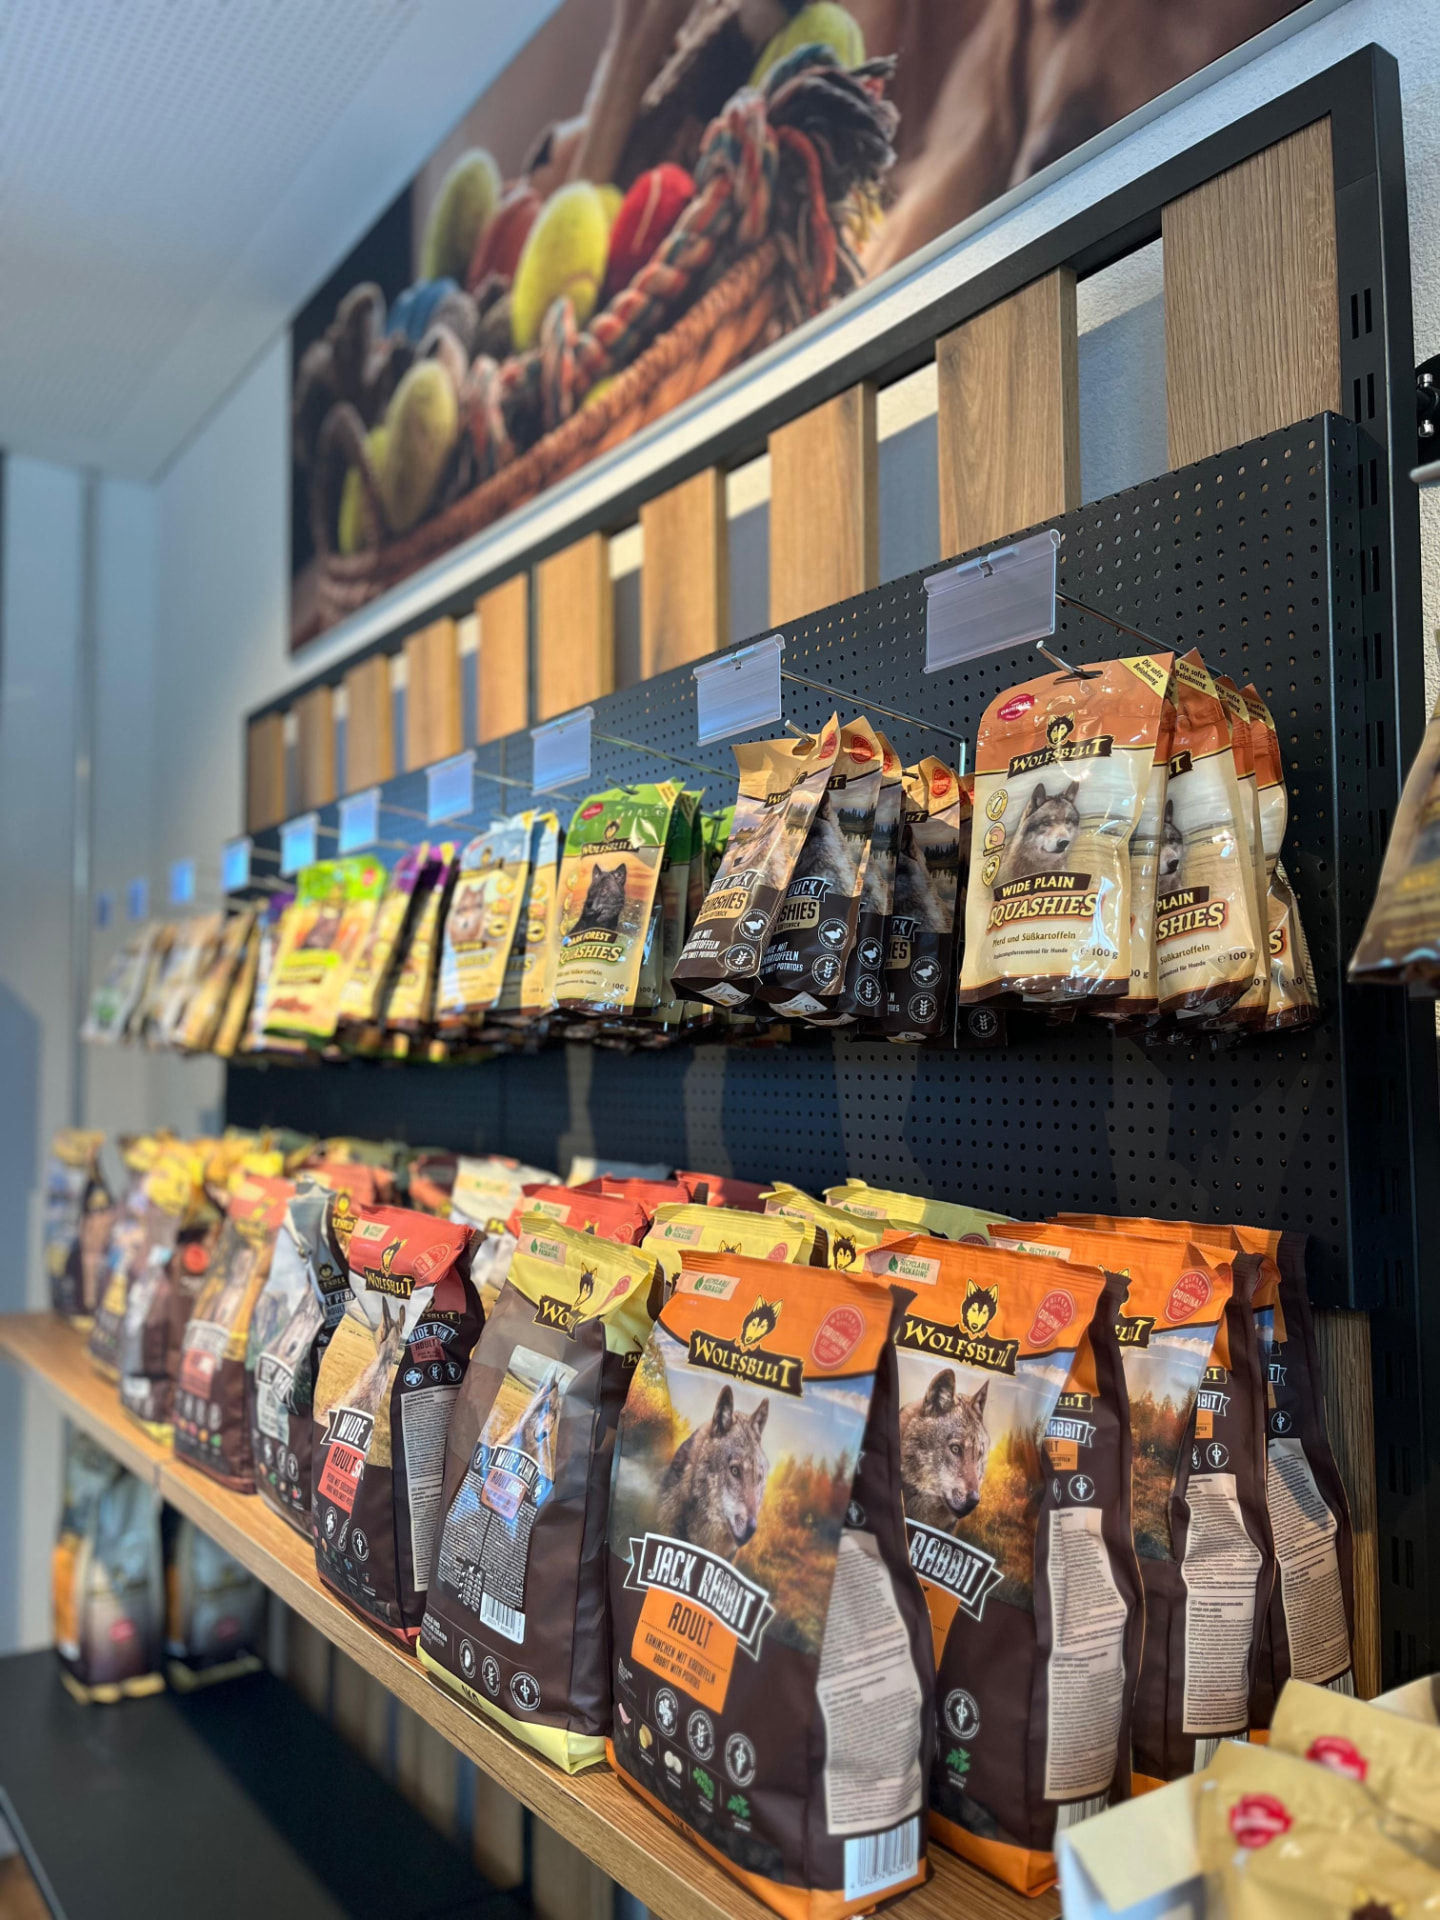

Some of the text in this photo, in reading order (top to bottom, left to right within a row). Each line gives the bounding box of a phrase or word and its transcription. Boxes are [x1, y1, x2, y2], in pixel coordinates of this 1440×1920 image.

[1141, 659, 1164, 679] Die softe
[1179, 662, 1207, 681] Die softe
[1012, 738, 1109, 772] WOLFSBLUT
[1002, 876, 1075, 898] WIDE PLAIN
[987, 893, 1100, 930] SQUASHIES
[1156, 891, 1194, 912] PLAIN
[1157, 902, 1226, 941] SHIES
[1022, 930, 1077, 942] Süßkartoffeln
[1092, 947, 1110, 957] 100
[1228, 951, 1247, 962] 100
[899, 1266, 928, 1279] PACKAGING
[900, 1258, 930, 1271] RECYCLABLE
[365, 1271, 414, 1297] WOLFSBLUT
[903, 1319, 1016, 1368] WOLFSBLUT
[694, 1335, 798, 1388] WOLFSBLUT
[336, 1412, 369, 1446] WIDE
[909, 1530, 984, 1594] RABBIT
[647, 1544, 756, 1630] JACK RABBIT
[667, 1601, 714, 1649] ADULT
[675, 1649, 688, 1665] MIT
